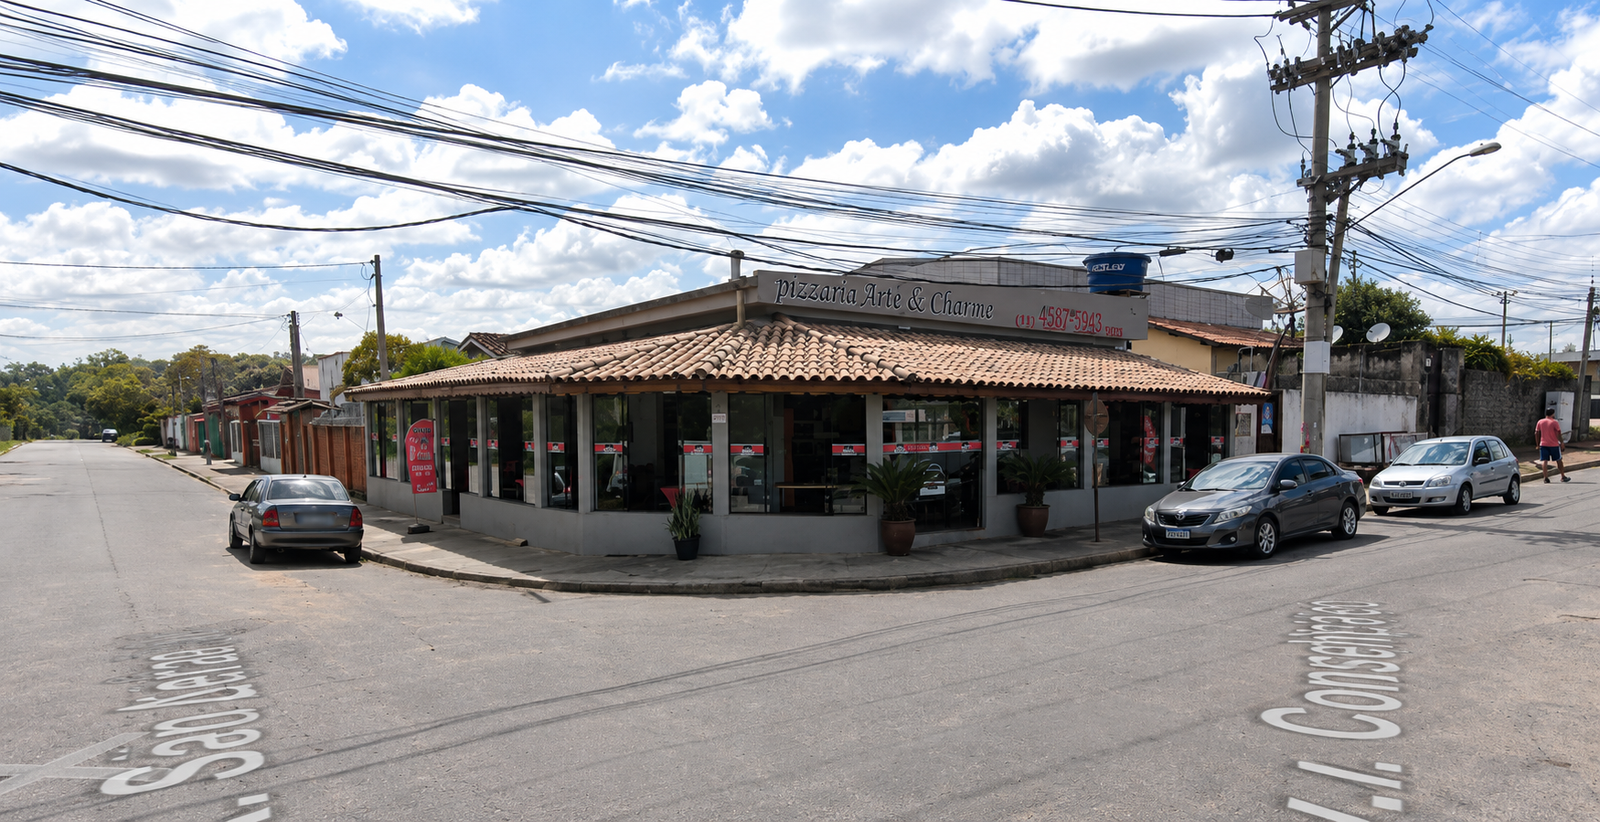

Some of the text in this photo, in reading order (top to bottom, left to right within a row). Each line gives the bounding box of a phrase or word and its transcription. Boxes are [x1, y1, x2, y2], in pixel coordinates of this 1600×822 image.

[774, 274, 857, 306] pizzaria
[907, 286, 927, 313] &
[929, 290, 994, 319] Charme
[1038, 305, 1103, 334] 4587-5943
